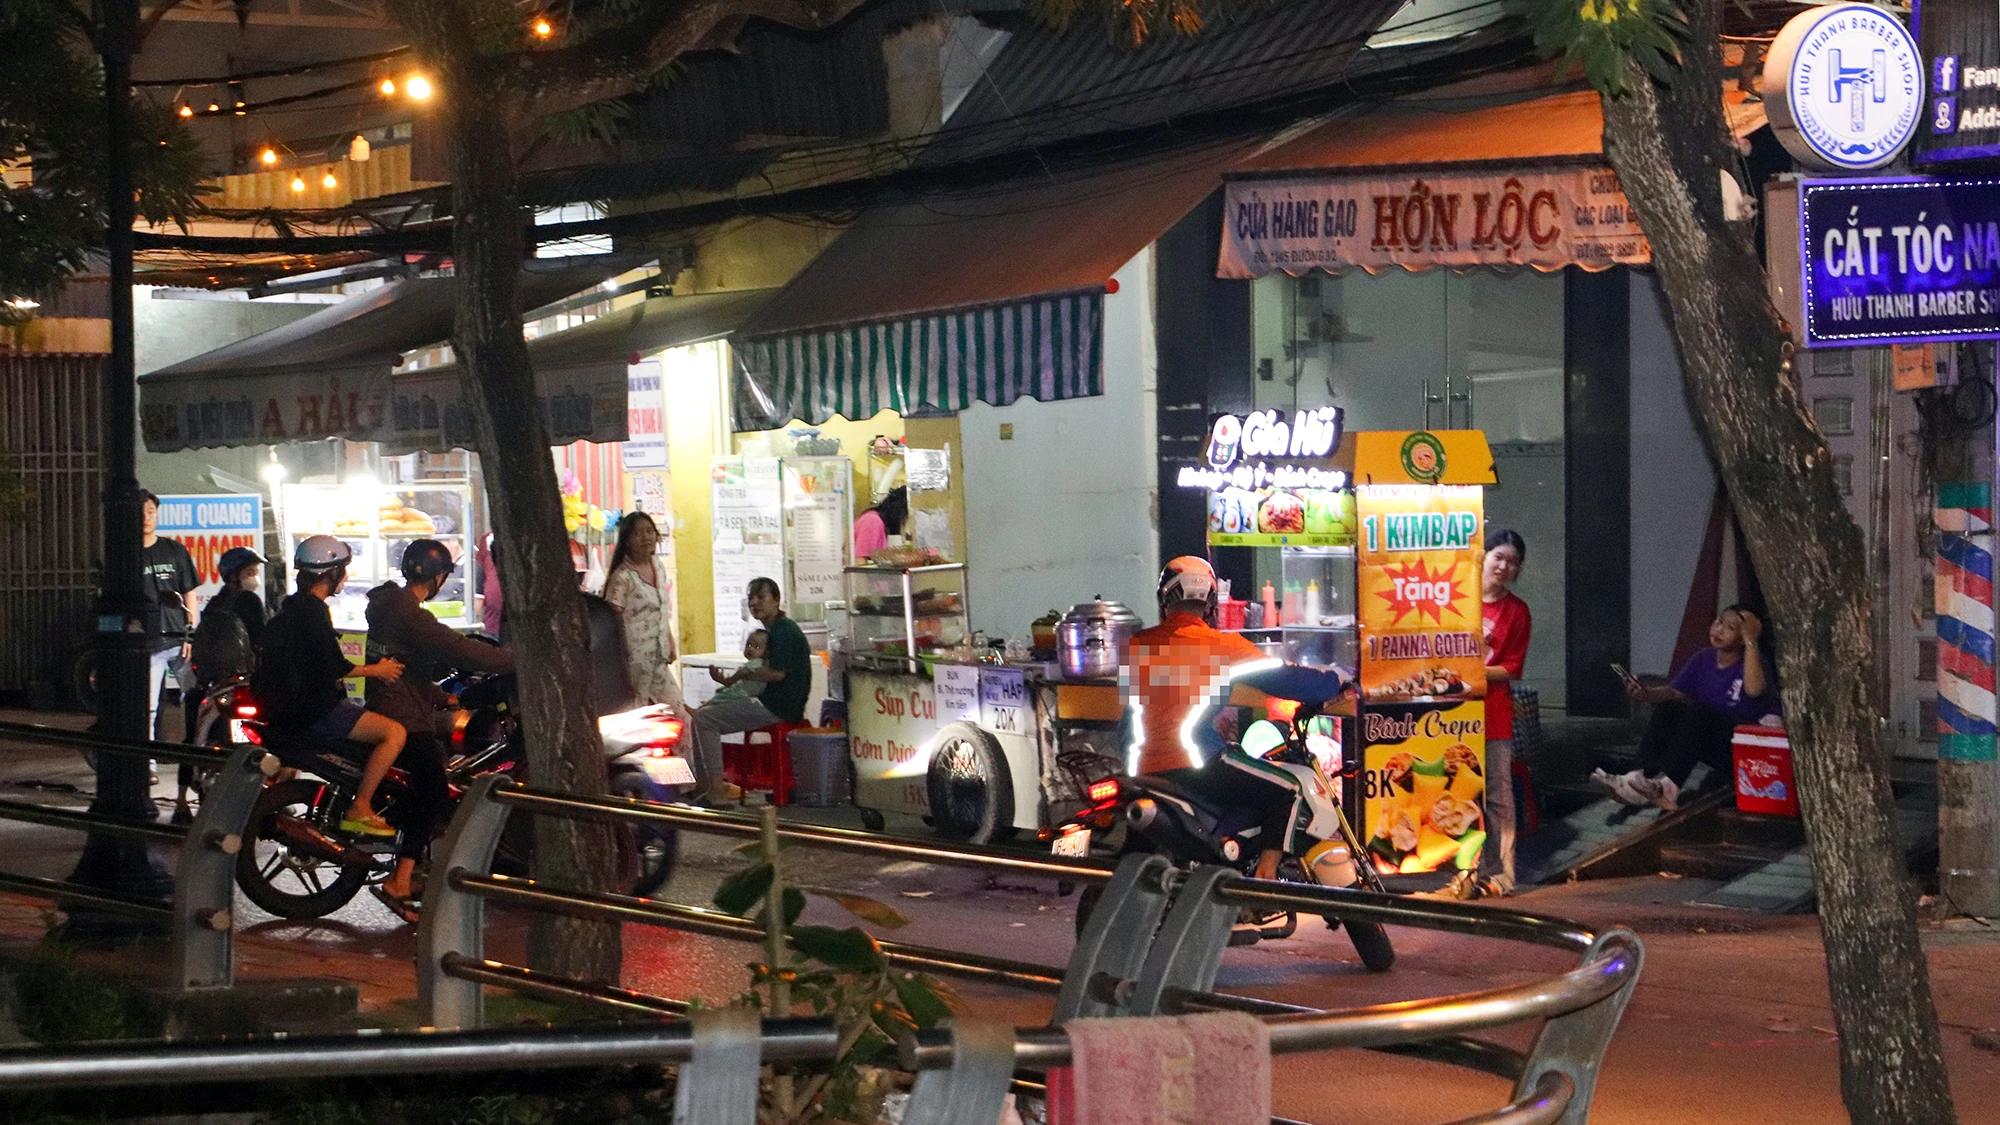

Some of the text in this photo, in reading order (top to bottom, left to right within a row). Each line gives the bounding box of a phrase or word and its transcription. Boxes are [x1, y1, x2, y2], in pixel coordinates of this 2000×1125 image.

[1807, 18, 1846, 59] THANH
[1851, 16, 1900, 51] BARBER
[1896, 52, 1914, 97] SHOP
[1963, 66, 2000, 90] Fan
[1238, 191, 1268, 240] CỬA
[1273, 193, 1319, 239] HÀNG
[1324, 199, 1357, 246] GẠO
[1471, 176, 1561, 262] LỘC
[1824, 205, 1883, 278] CẮT
[1891, 211, 1954, 275] TÓC
[1918, 289, 1976, 317] BARBER
[196, 502, 252, 528] QUANG
[1364, 511, 1478, 552] 1 KIMBAP
[1393, 576, 1450, 607] Tặng
[1369, 631, 1482, 662] 1 PANNA COTTA
[994, 707, 1016, 731] 20K
[1364, 709, 1484, 742] Bánh Crepe
[1365, 768, 1396, 799] 8K
